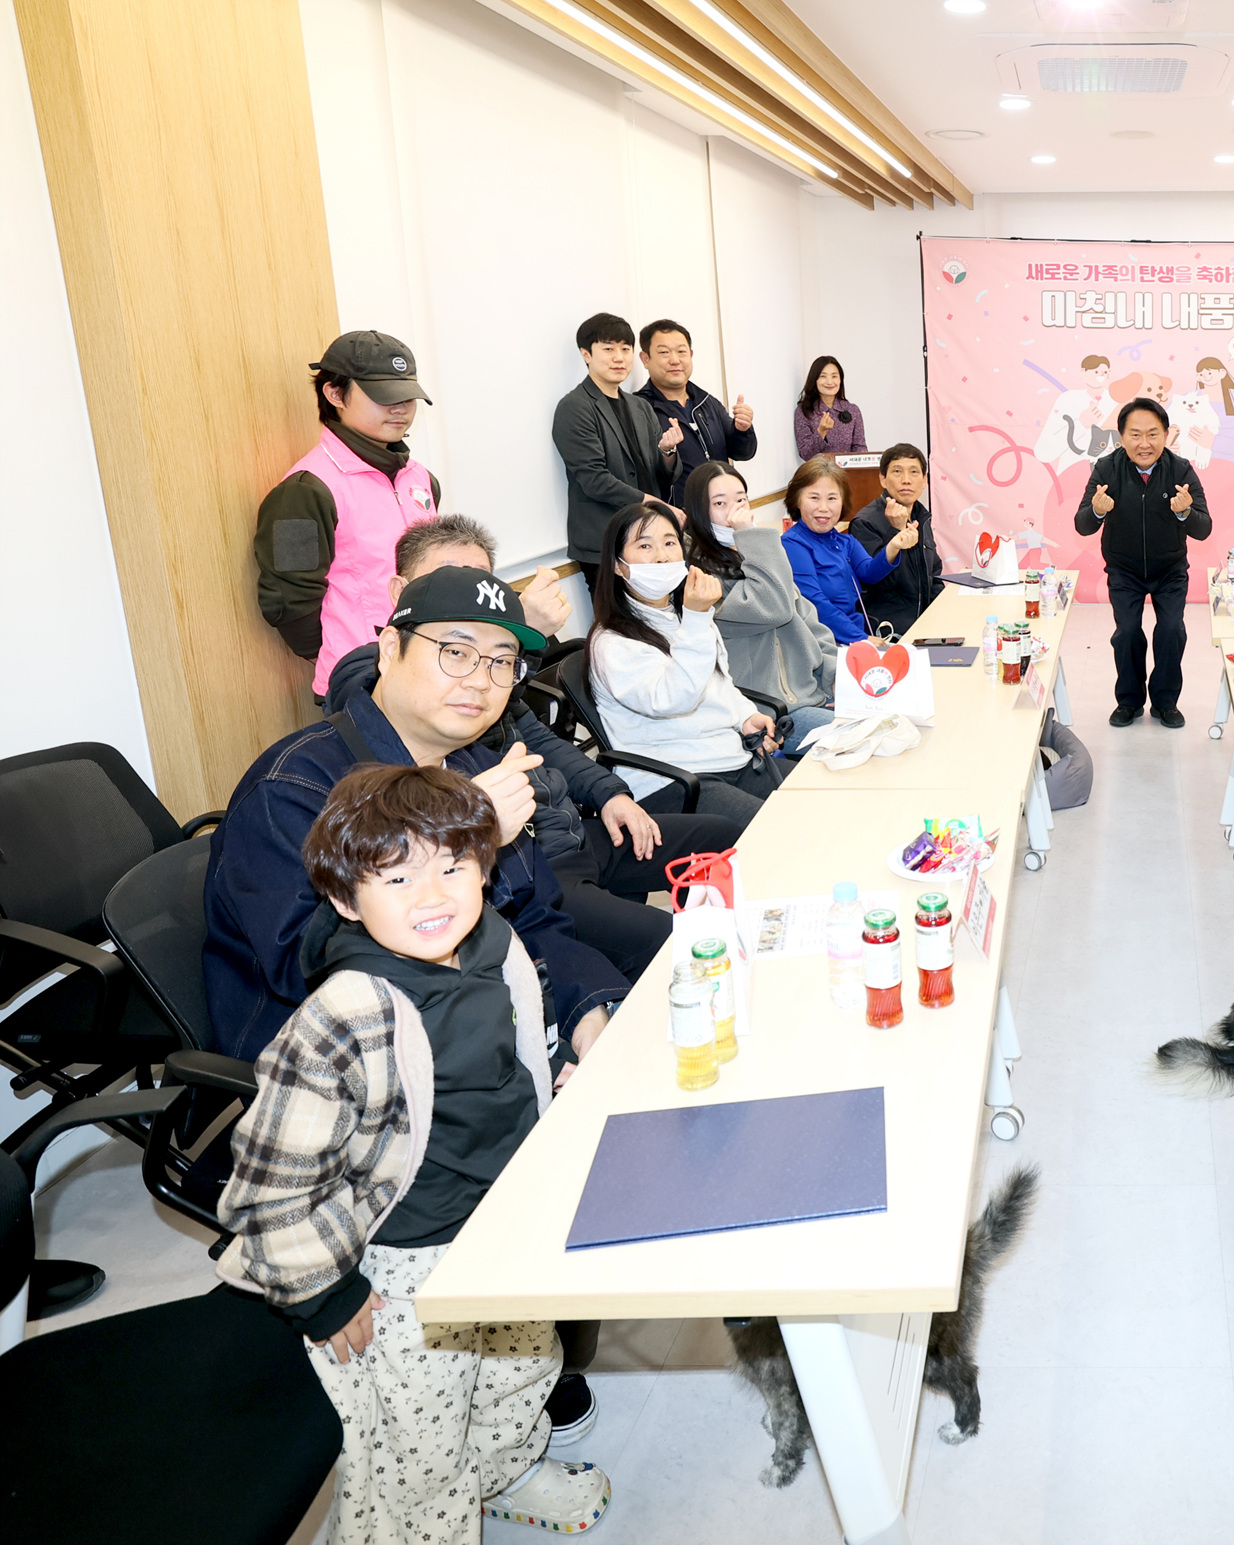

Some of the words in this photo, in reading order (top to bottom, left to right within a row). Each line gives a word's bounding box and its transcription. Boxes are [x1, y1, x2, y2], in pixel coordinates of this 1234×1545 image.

[1026, 264, 1080, 281] 새로운
[1082, 264, 1136, 282] 가족의
[1139, 266, 1192, 283] 탄생을
[1042, 290, 1153, 329] 마침내
[476, 580, 507, 612] NY
